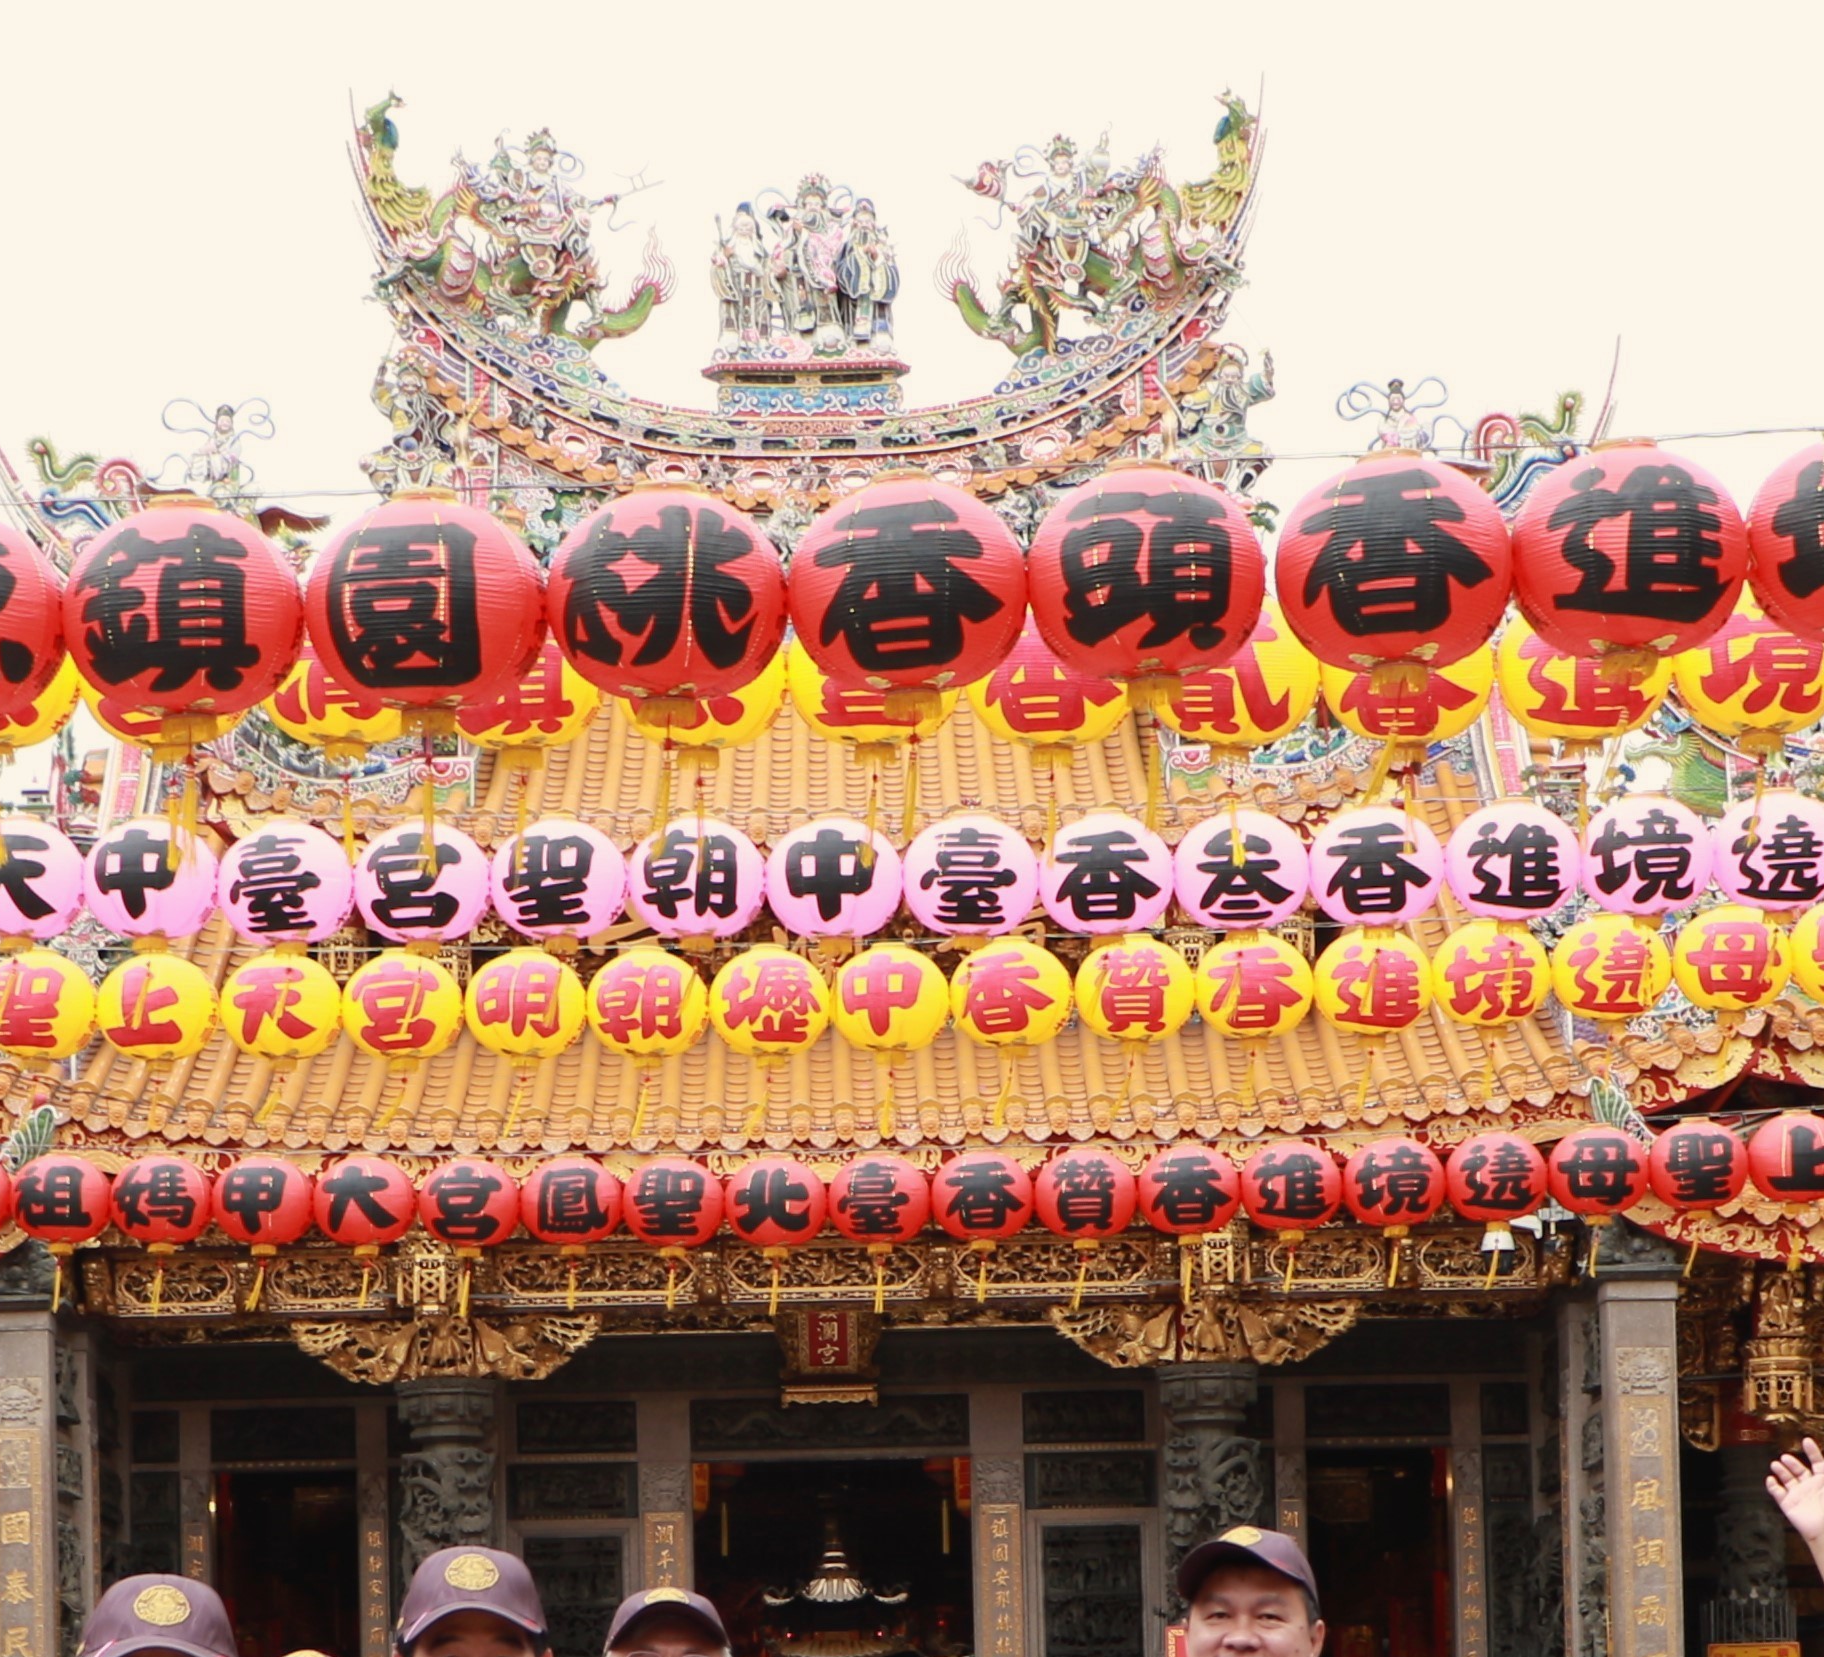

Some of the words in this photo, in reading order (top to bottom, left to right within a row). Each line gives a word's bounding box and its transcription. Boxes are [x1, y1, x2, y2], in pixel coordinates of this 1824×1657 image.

[562, 505, 759, 669] 桃
[815, 498, 1004, 671] 香
[1060, 491, 1229, 650] 頭
[1301, 469, 1494, 635] 香
[1547, 464, 1735, 622] 進
[82, 524, 260, 691] 鎮
[327, 523, 482, 686] 園
[94, 830, 181, 917] 中
[230, 835, 320, 932] 臺
[368, 833, 461, 929] 宮
[504, 835, 595, 927] 聖
[643, 831, 738, 918] 朝
[785, 829, 878, 921] 中
[921, 828, 1017, 925] 臺
[1057, 830, 1160, 921] 香
[1326, 823, 1431, 914] 香
[1467, 823, 1565, 910] 進
[1592, 809, 1694, 901] 境
